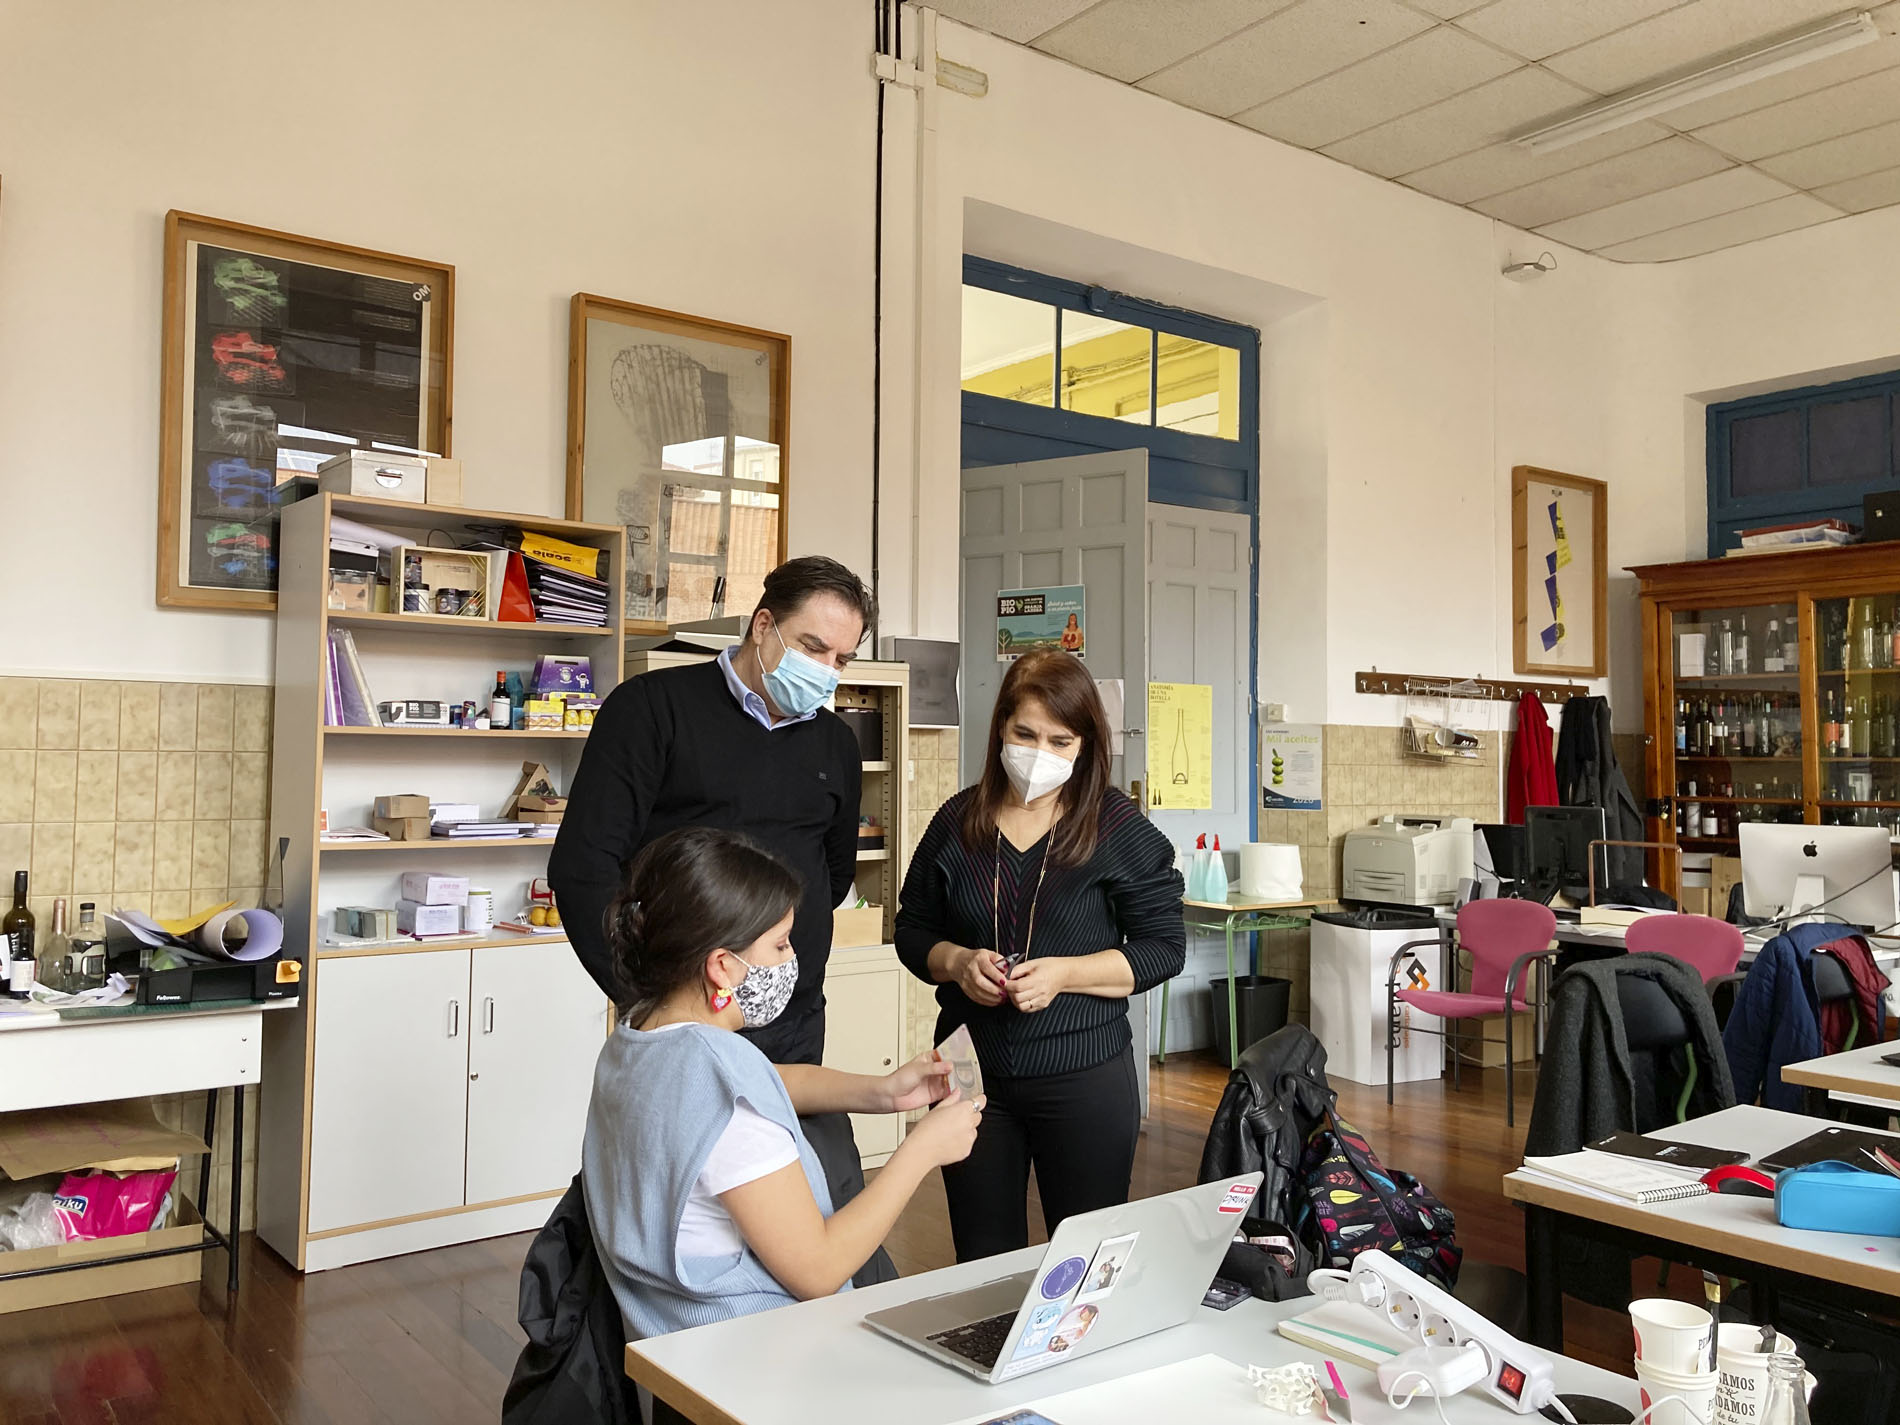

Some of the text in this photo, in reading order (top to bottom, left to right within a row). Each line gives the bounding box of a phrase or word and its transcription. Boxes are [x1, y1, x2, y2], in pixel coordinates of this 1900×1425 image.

[412, 284, 431, 301] OM
[1000, 599, 1016, 607] BIO
[1000, 606, 1016, 615] PIO
